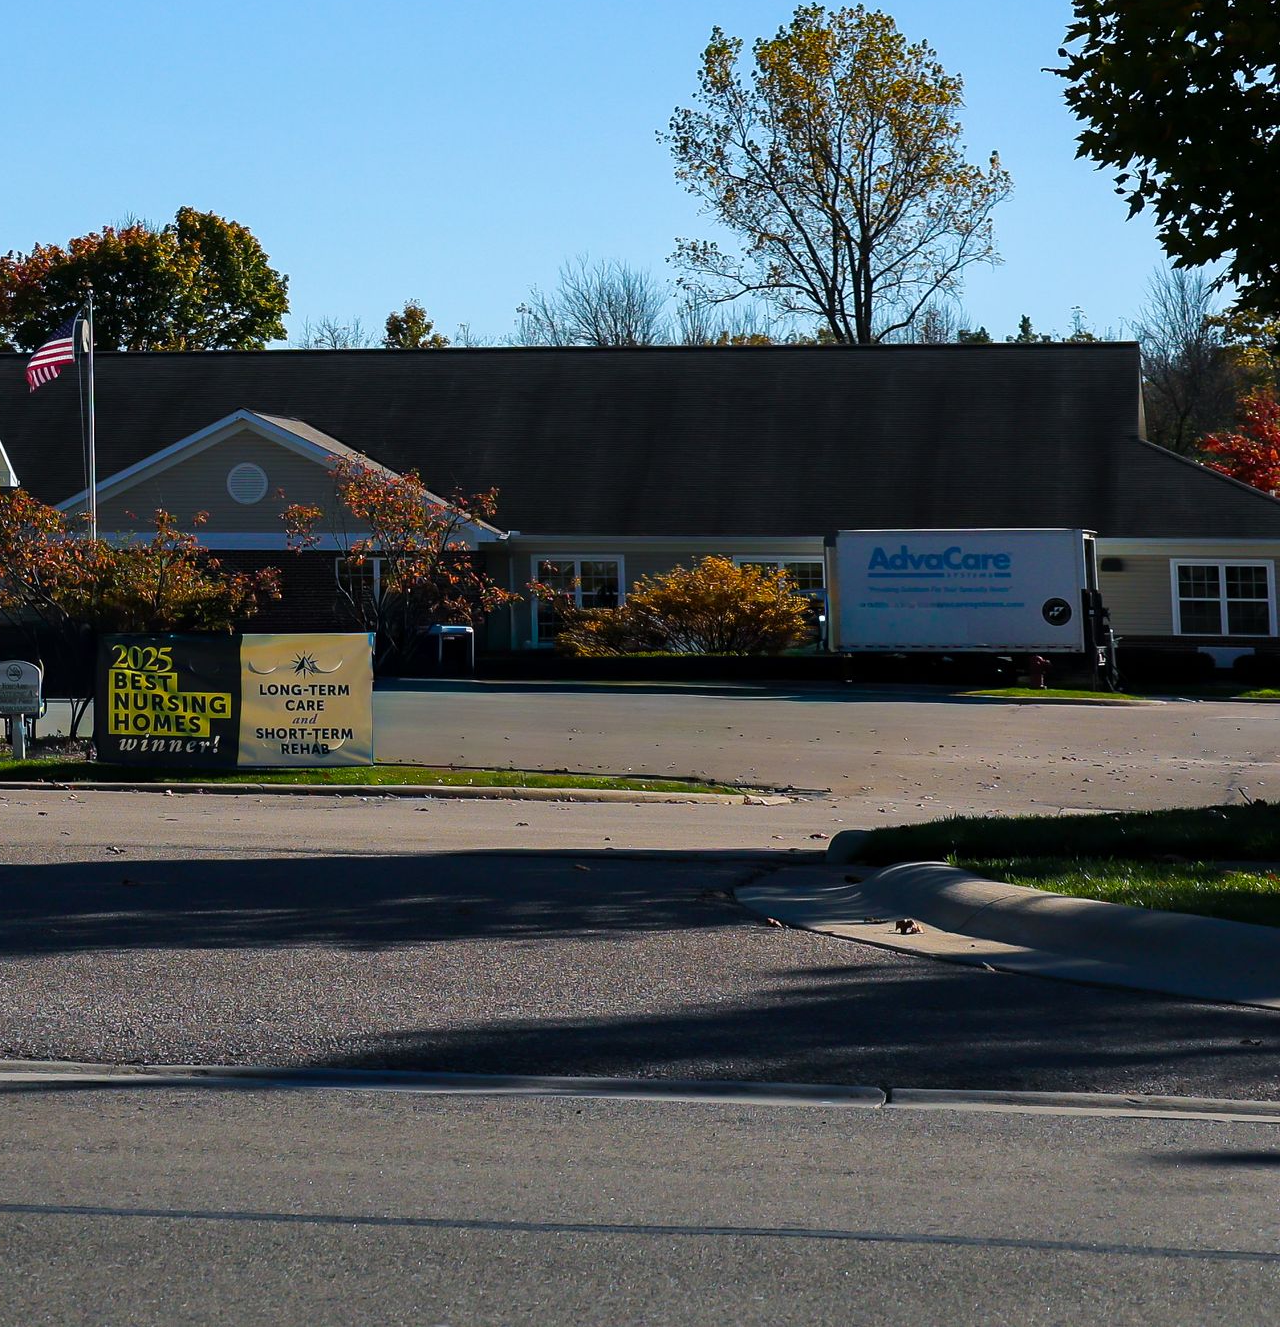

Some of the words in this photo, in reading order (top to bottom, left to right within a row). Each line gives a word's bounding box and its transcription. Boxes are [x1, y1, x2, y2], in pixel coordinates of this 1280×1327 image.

[868, 545, 1011, 570] AdvaCare
[111, 644, 172, 672] 2025
[114, 672, 172, 692] BEST
[260, 684, 350, 696] LONG-TERM
[113, 693, 227, 714] NURSING
[285, 700, 324, 711] CARE
[113, 713, 201, 733] HOMES
[292, 714, 317, 724] and
[119, 734, 220, 754] winner!
[256, 728, 353, 740] SHORT-TERM
[281, 744, 329, 755] REHAB
